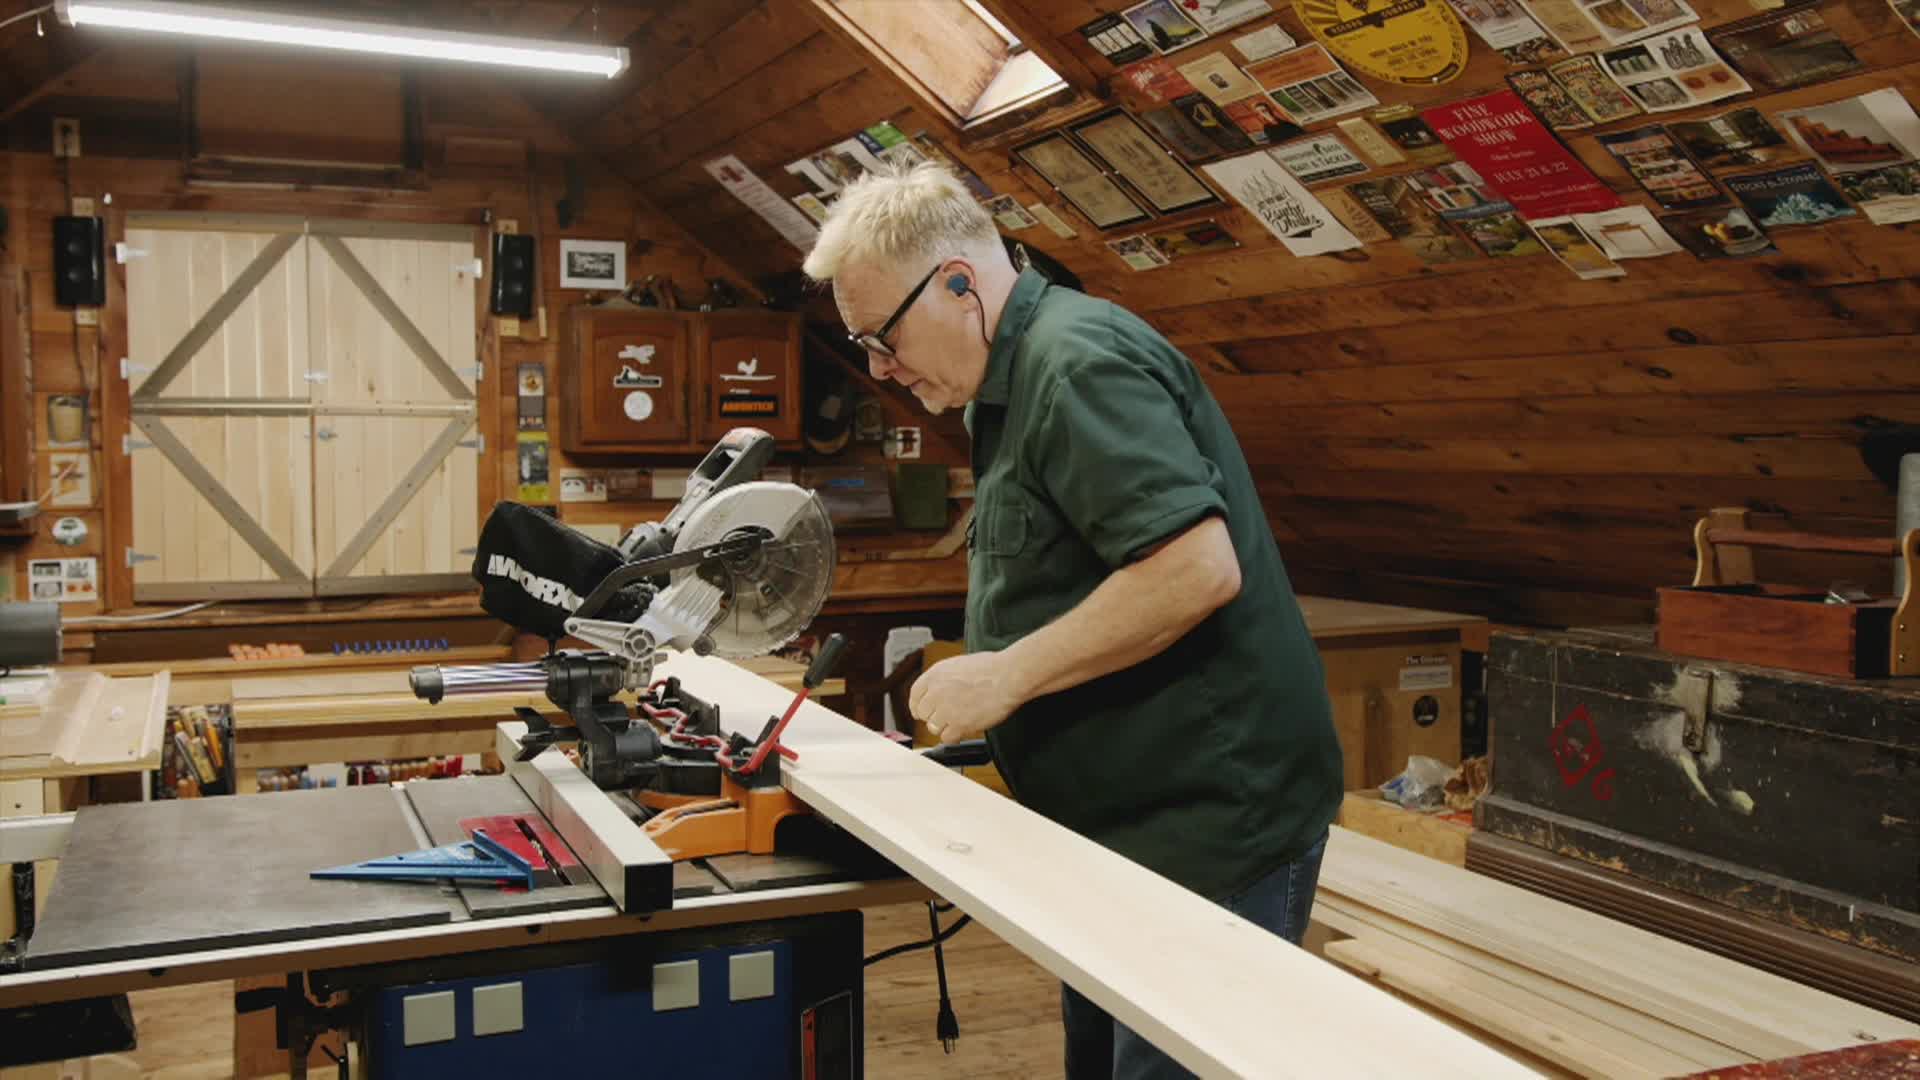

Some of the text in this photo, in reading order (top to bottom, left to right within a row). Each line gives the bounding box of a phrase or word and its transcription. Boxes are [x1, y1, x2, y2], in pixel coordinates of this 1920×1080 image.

[1453, 103, 1493, 122] FINE
[1439, 109, 1533, 141] WOODWORK
[1473, 128, 1518, 147] SHOW
[1493, 169, 1523, 185] JULY
[1552, 161, 1569, 173] 22
[487, 554, 584, 613] WORX
